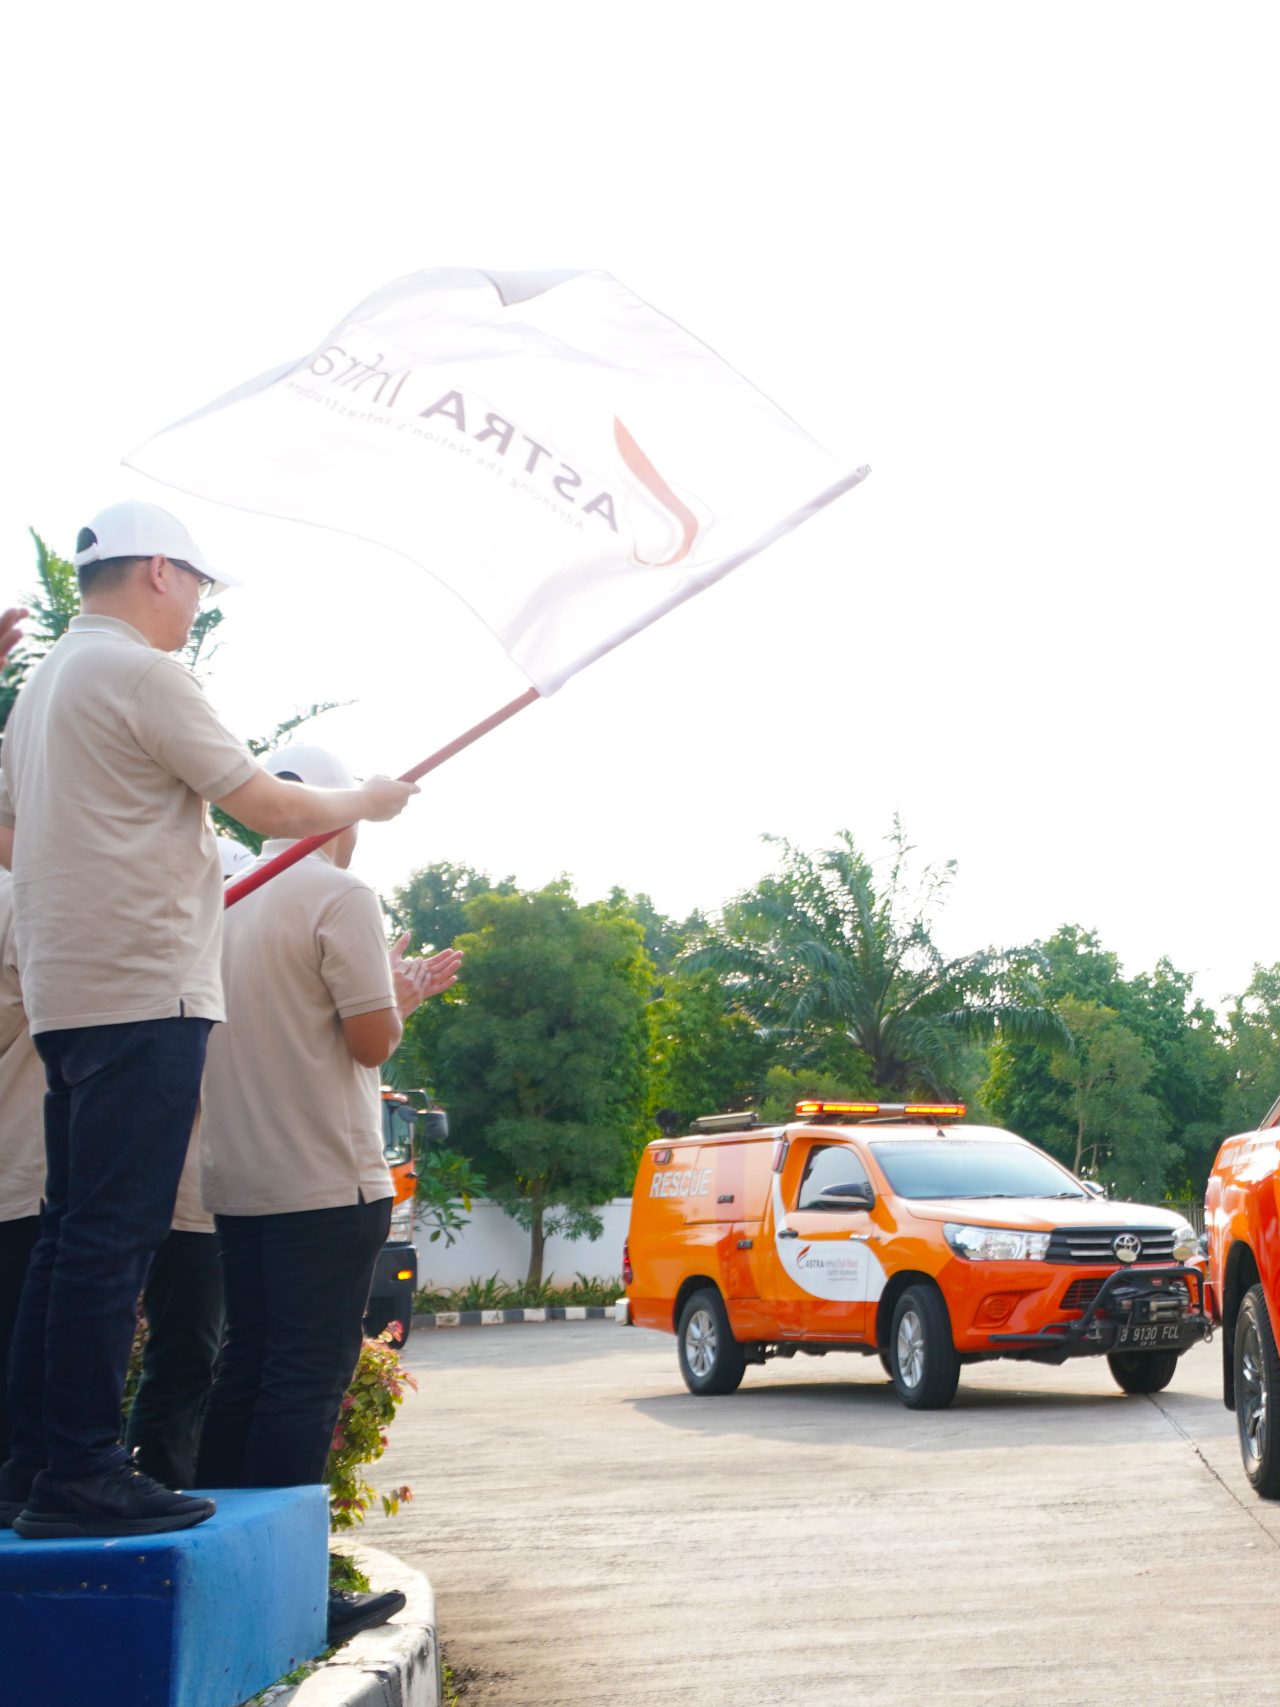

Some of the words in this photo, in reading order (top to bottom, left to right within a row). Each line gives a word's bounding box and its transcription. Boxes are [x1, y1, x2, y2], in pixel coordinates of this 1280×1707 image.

[649, 1168, 713, 1198] RESCUE
[805, 1260, 824, 1269] ASTRA
[1133, 1326, 1158, 1341] 9130
[1162, 1326, 1180, 1339] FCL
